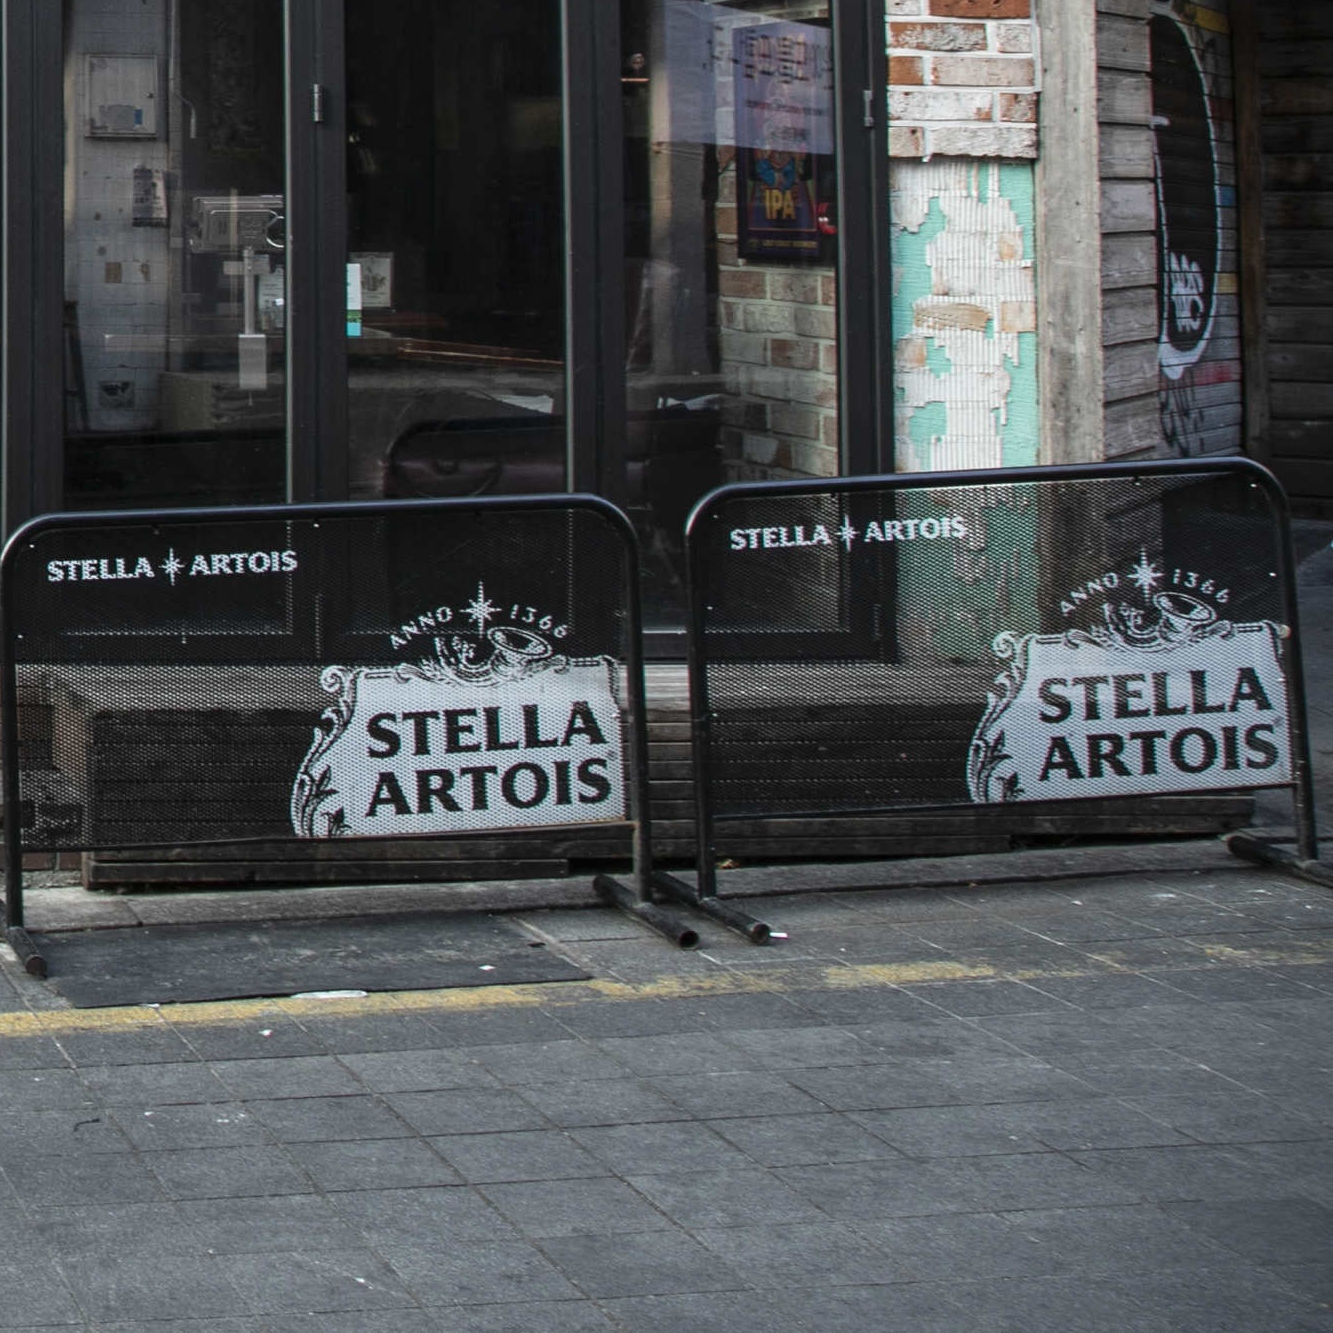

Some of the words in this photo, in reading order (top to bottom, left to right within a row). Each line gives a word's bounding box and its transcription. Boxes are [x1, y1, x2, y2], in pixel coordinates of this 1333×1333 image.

[763, 189, 798, 220] IPA
[729, 526, 832, 551] STELLA
[864, 515, 967, 543] ARTOIS
[46, 556, 156, 582] STELLA
[190, 550, 299, 576] ARTOIS
[1059, 571, 1120, 617] ANNO
[1172, 568, 1231, 605] 1366
[389, 605, 454, 650] ANNO
[509, 602, 570, 640] 1366
[1037, 667, 1274, 724] STELLA
[366, 700, 607, 760] STELLA
[1038, 723, 1280, 782] ARTOIS
[365, 758, 612, 818] ARTOIS
